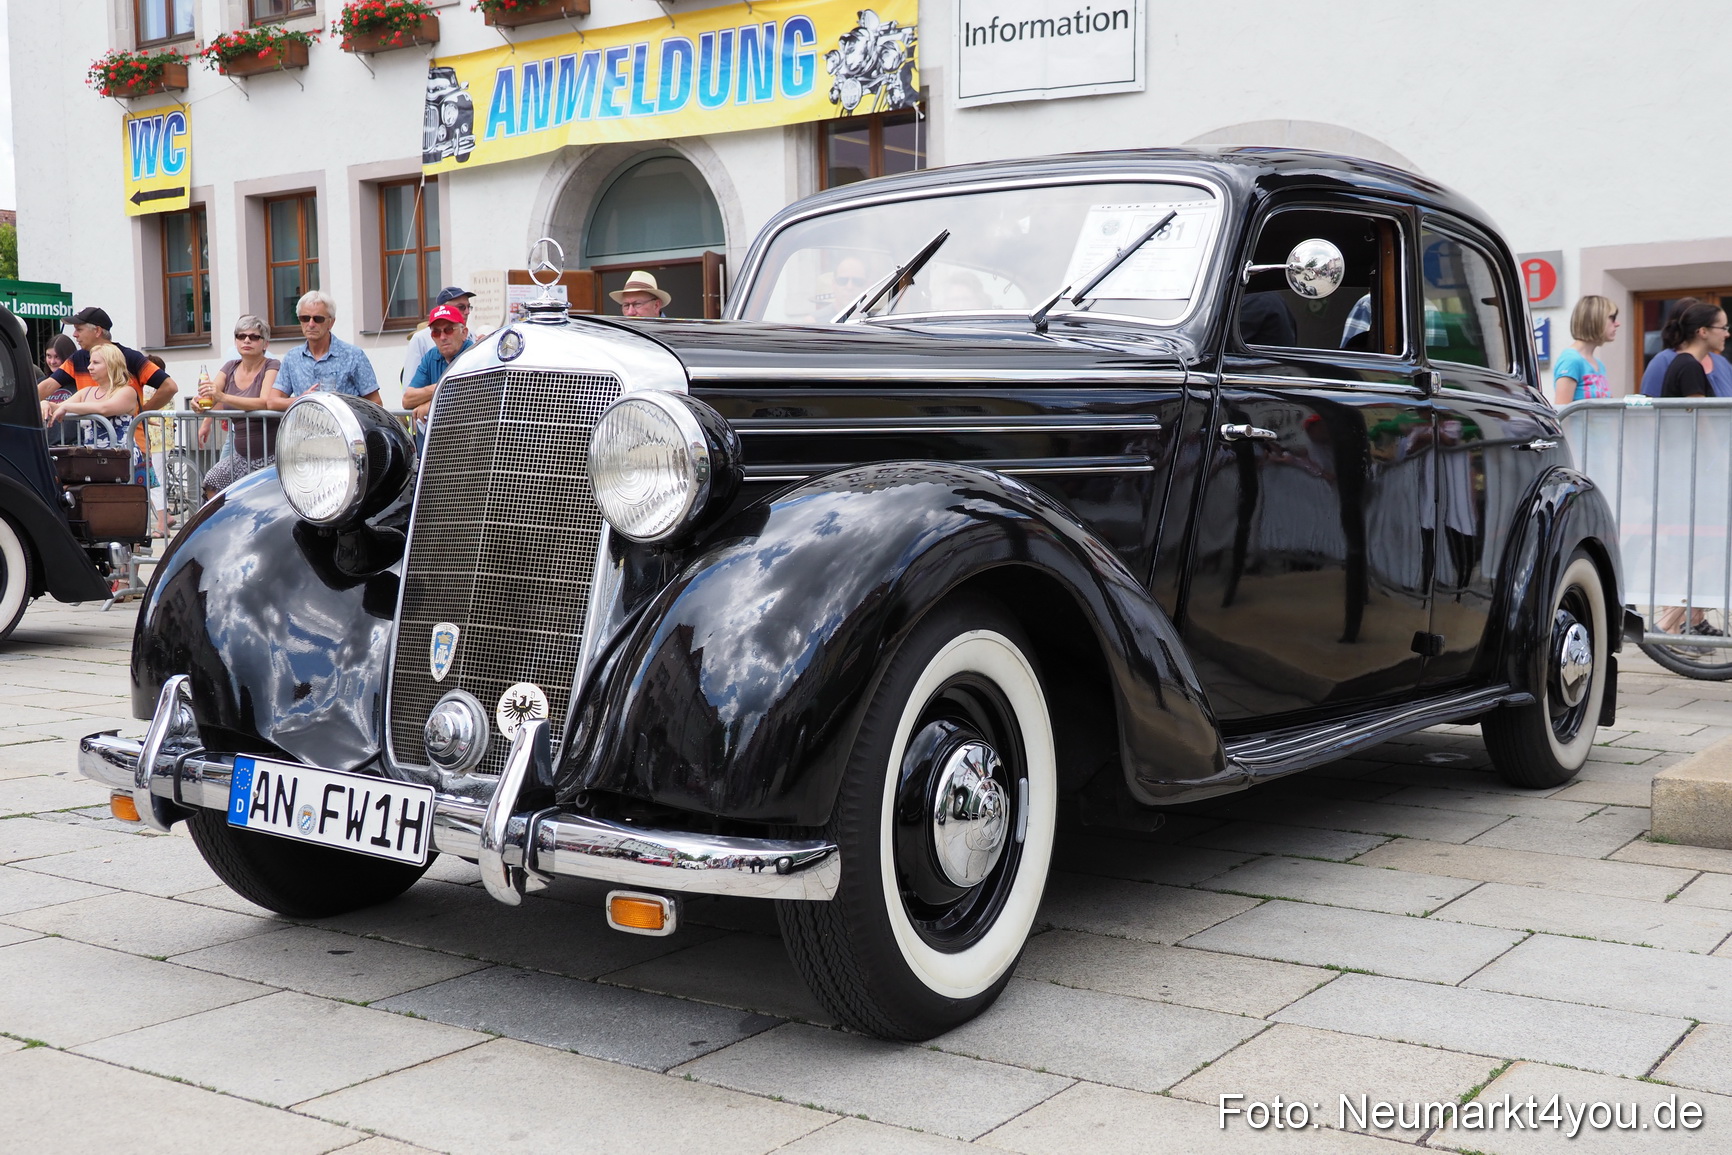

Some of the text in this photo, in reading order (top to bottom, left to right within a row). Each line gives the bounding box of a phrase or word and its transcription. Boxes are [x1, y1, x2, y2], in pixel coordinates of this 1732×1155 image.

[965, 6, 1129, 47] Information
[484, 15, 818, 141] ANMELDUNG
[128, 111, 187, 181] WC
[12, 298, 73, 317] Lammsbr
[46, 393, 61, 401] ard
[235, 798, 244, 813] D
[249, 770, 298, 828] AN
[318, 783, 426, 855] FW1H
